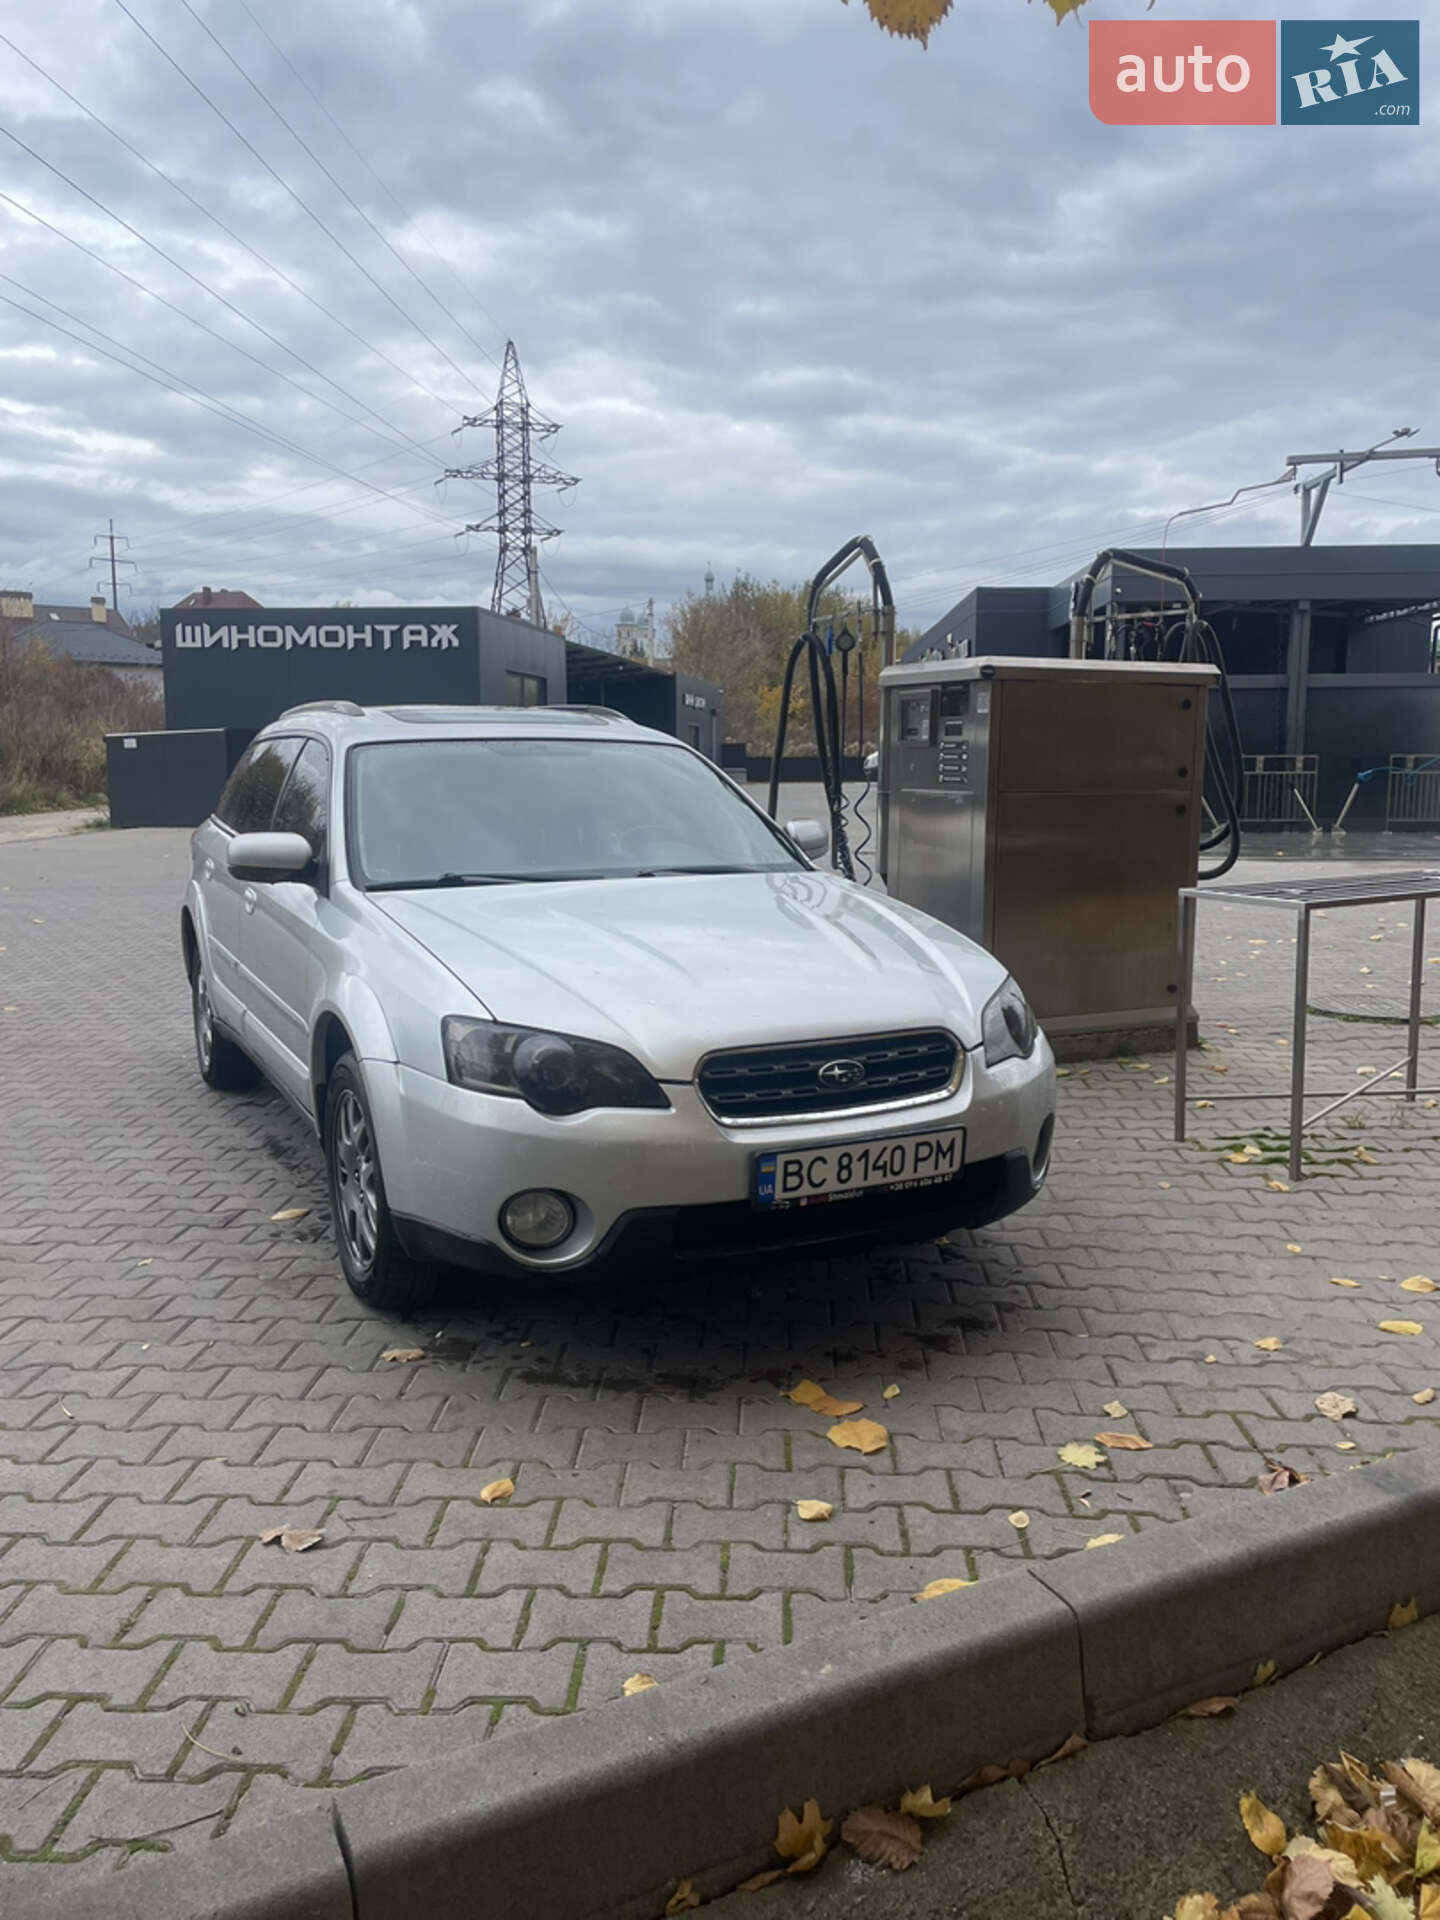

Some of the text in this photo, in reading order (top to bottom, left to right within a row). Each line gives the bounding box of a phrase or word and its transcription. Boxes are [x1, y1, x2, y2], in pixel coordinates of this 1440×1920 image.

[175, 622, 460, 650] ШИНОМОНТАЖ
[782, 1137, 956, 1193] BC 8140 PM
